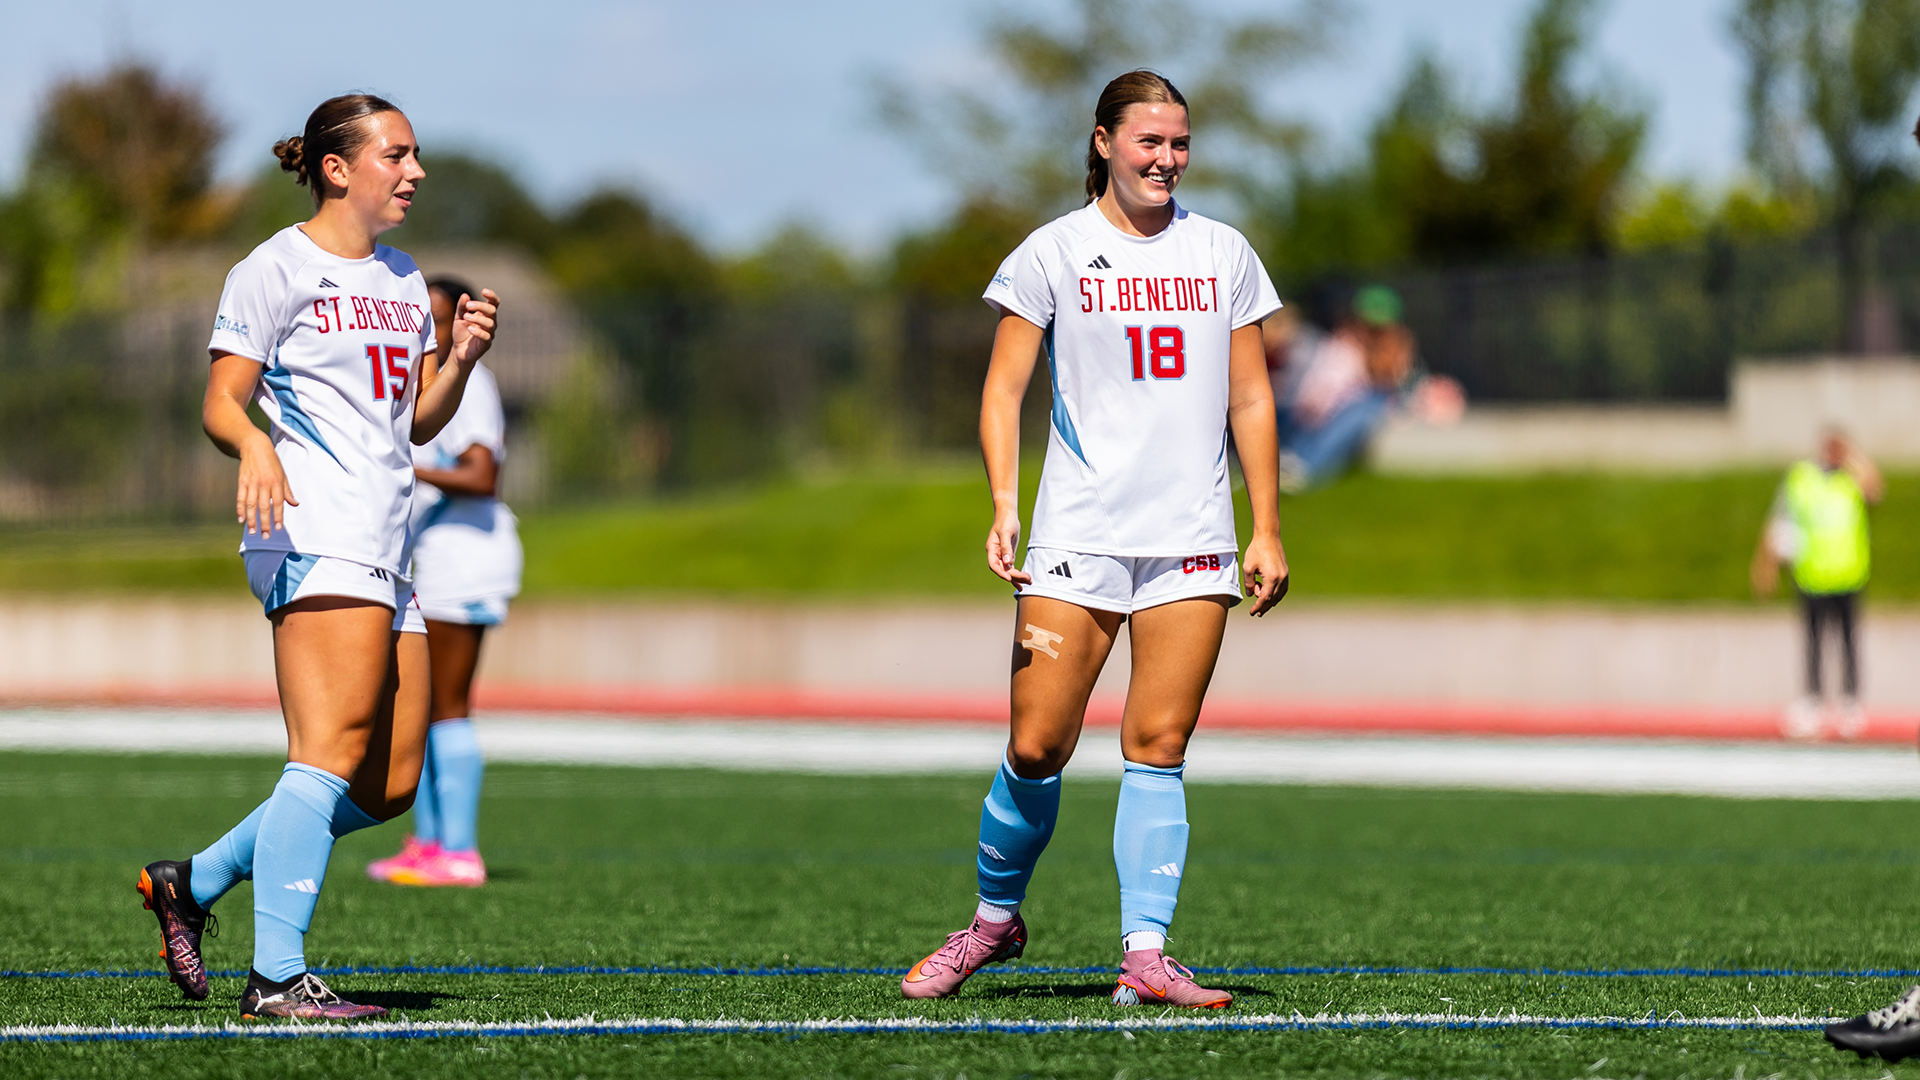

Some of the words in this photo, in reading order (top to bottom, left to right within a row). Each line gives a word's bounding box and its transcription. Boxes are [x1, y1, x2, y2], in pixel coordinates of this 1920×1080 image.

[992, 273, 1011, 287] AC
[1079, 277, 1218, 313] ST.BENEDICT
[313, 296, 425, 334] ST.BENEDICT
[1124, 325, 1187, 381] 18
[364, 343, 410, 402] 15
[1182, 553, 1221, 575] CSB
